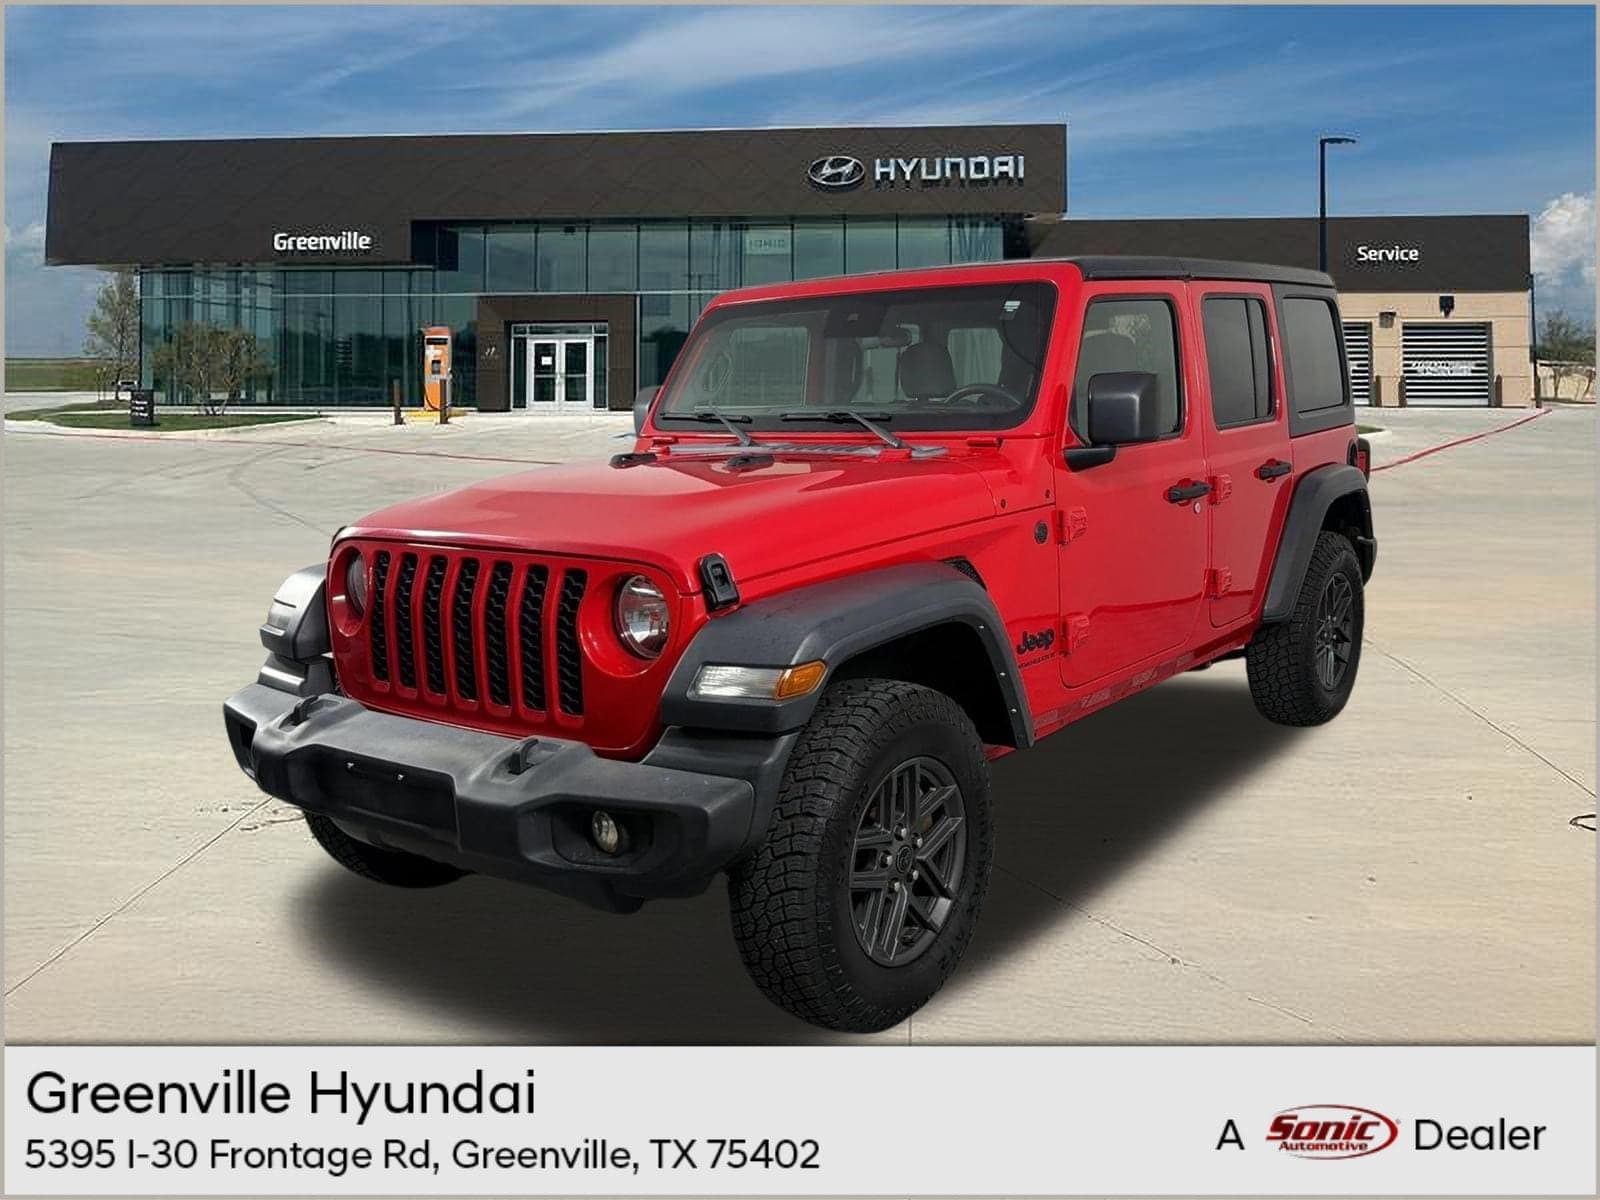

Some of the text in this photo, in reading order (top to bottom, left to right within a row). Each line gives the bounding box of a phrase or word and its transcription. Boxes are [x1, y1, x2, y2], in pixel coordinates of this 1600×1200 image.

[875, 156, 1025, 181] HYUNDAI
[273, 231, 372, 251] Greenville
[1357, 245, 1419, 261] Service
[1016, 629, 1055, 655] Jeep
